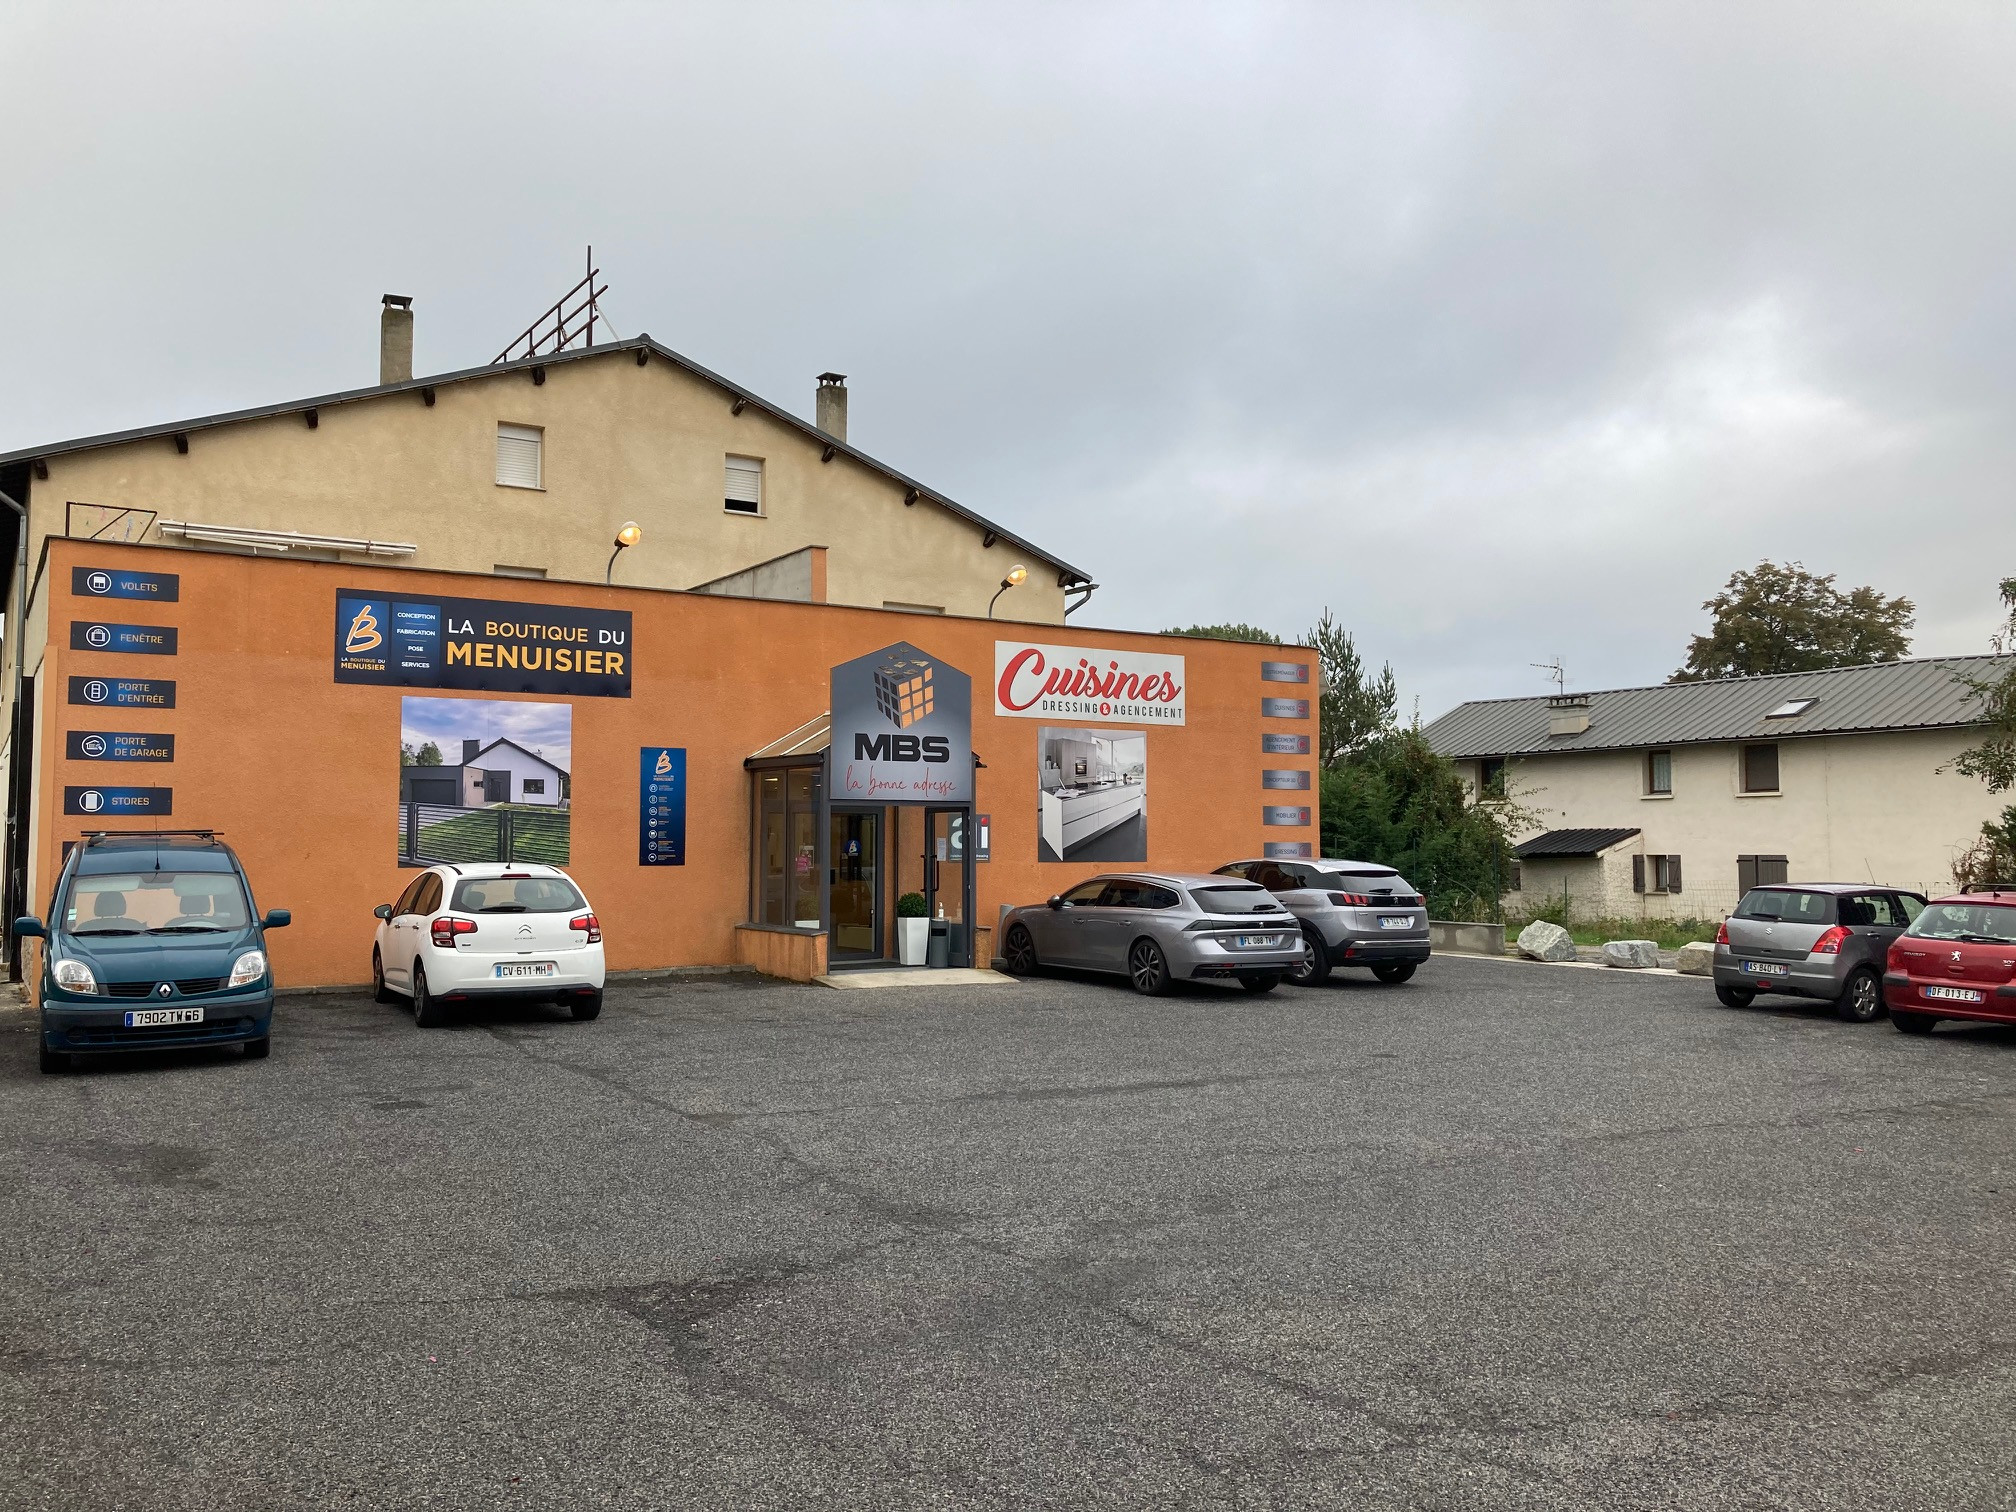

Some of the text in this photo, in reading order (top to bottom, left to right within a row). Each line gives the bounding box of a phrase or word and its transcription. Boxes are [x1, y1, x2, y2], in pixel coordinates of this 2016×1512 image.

[120, 581, 158, 592] VOLETS
[397, 612, 436, 620] CONCEPTION
[396, 628, 436, 636] FABRICATION
[448, 618, 625, 646] LA BOUTIQUE DU
[120, 633, 163, 644] FENÊTRE
[446, 641, 625, 676] MENUISIER
[340, 662, 386, 671] MENUISIER
[401, 661, 430, 669] SERVICES
[997, 648, 1182, 712] Cuisines
[118, 682, 150, 692] PORTE
[117, 693, 165, 704] D'ENTRÉE
[1042, 700, 1098, 714] DRESSING
[1113, 704, 1182, 719] AGENCEMENT
[115, 737, 147, 746] PORTE
[114, 748, 169, 758] DE GARAGE
[854, 732, 950, 764] MBS
[845, 765, 957, 798] la bonne adresse
[111, 797, 150, 806] STORES
[137, 1012, 167, 1024] 7902
